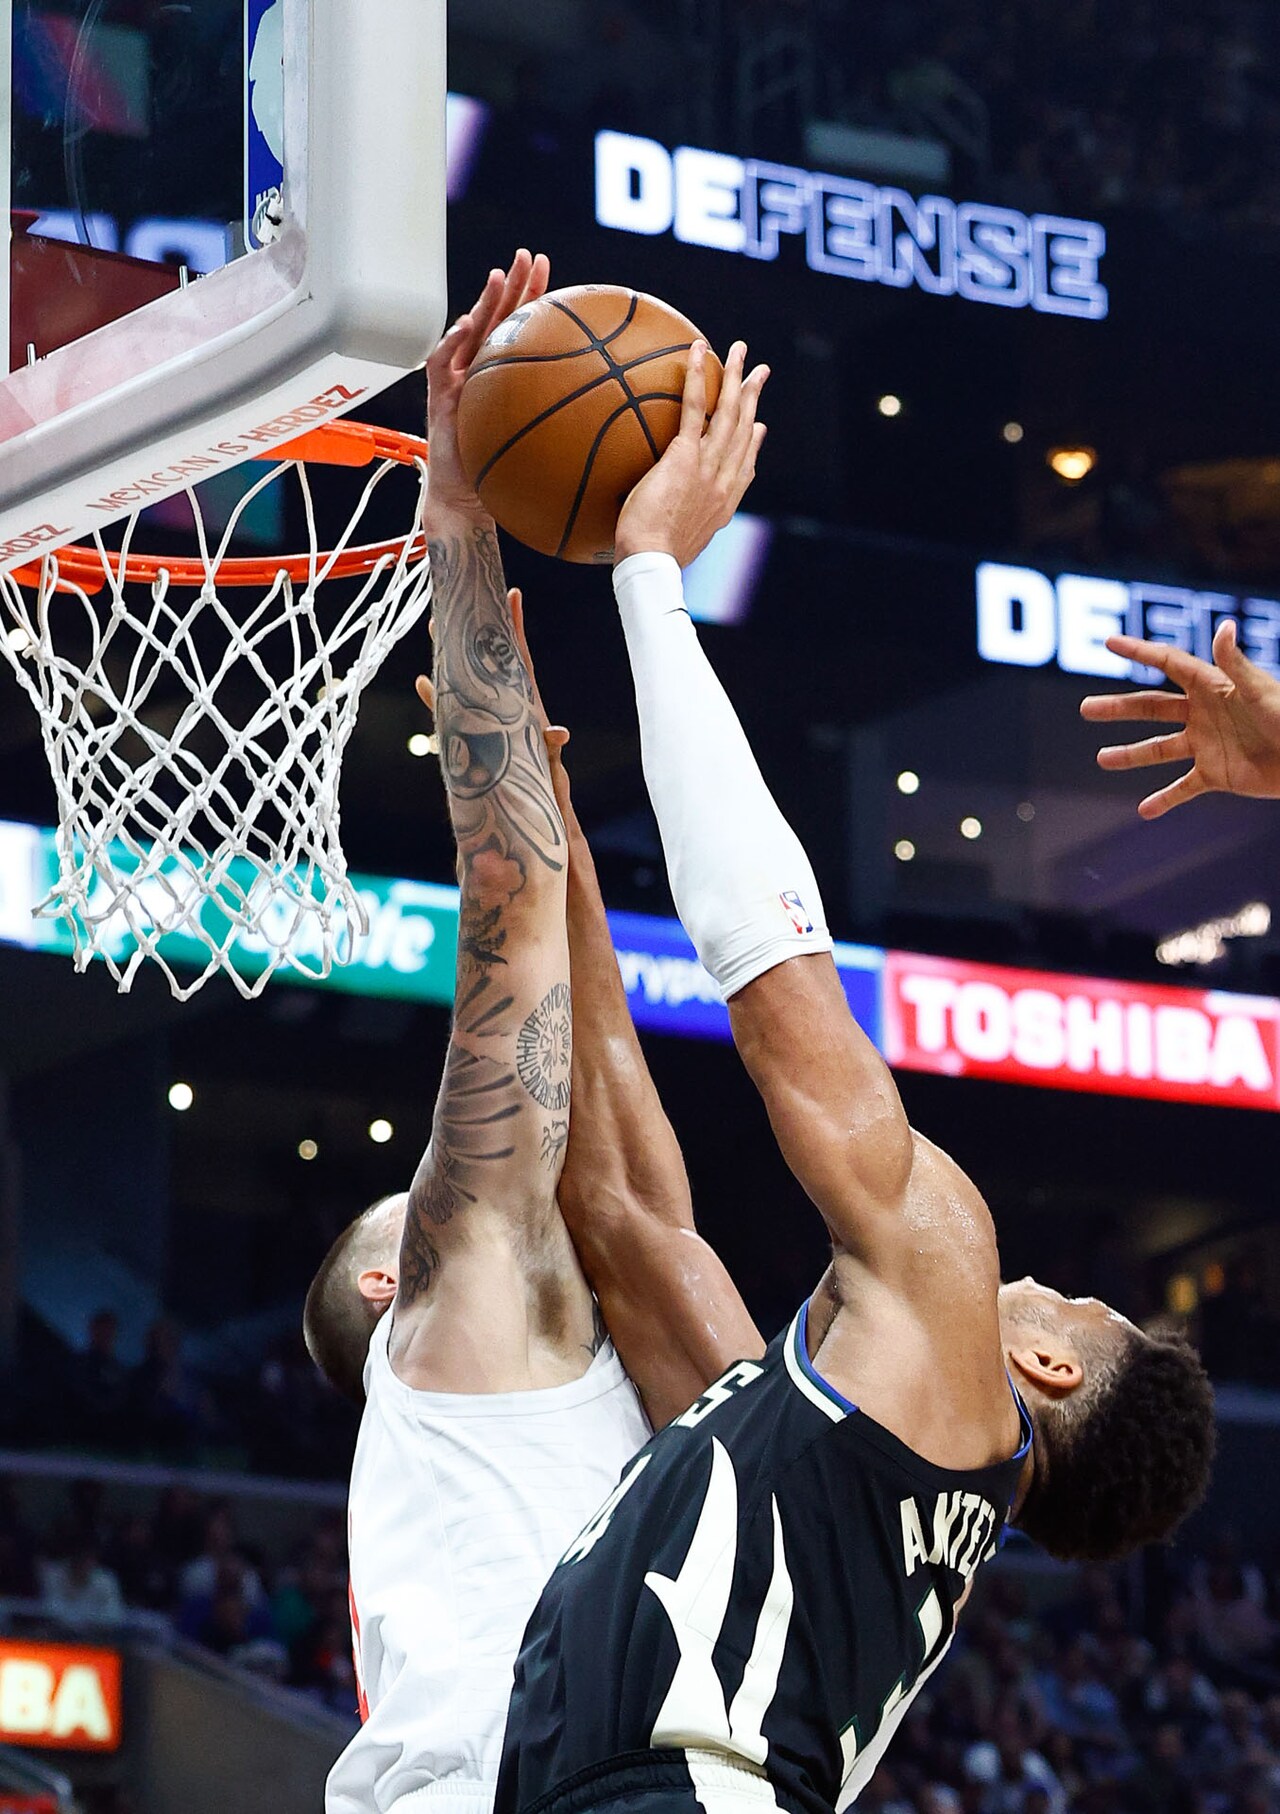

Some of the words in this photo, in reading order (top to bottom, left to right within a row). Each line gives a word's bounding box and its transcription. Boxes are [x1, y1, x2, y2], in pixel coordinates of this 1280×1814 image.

[594, 129, 1108, 320] DEFENSE
[208, 441, 249, 456] IS
[237, 384, 366, 442] HERDEZ
[0, 524, 73, 563] RDEZ
[902, 975, 1274, 1092] TOSHIBA
[0, 1657, 114, 1743] BA
